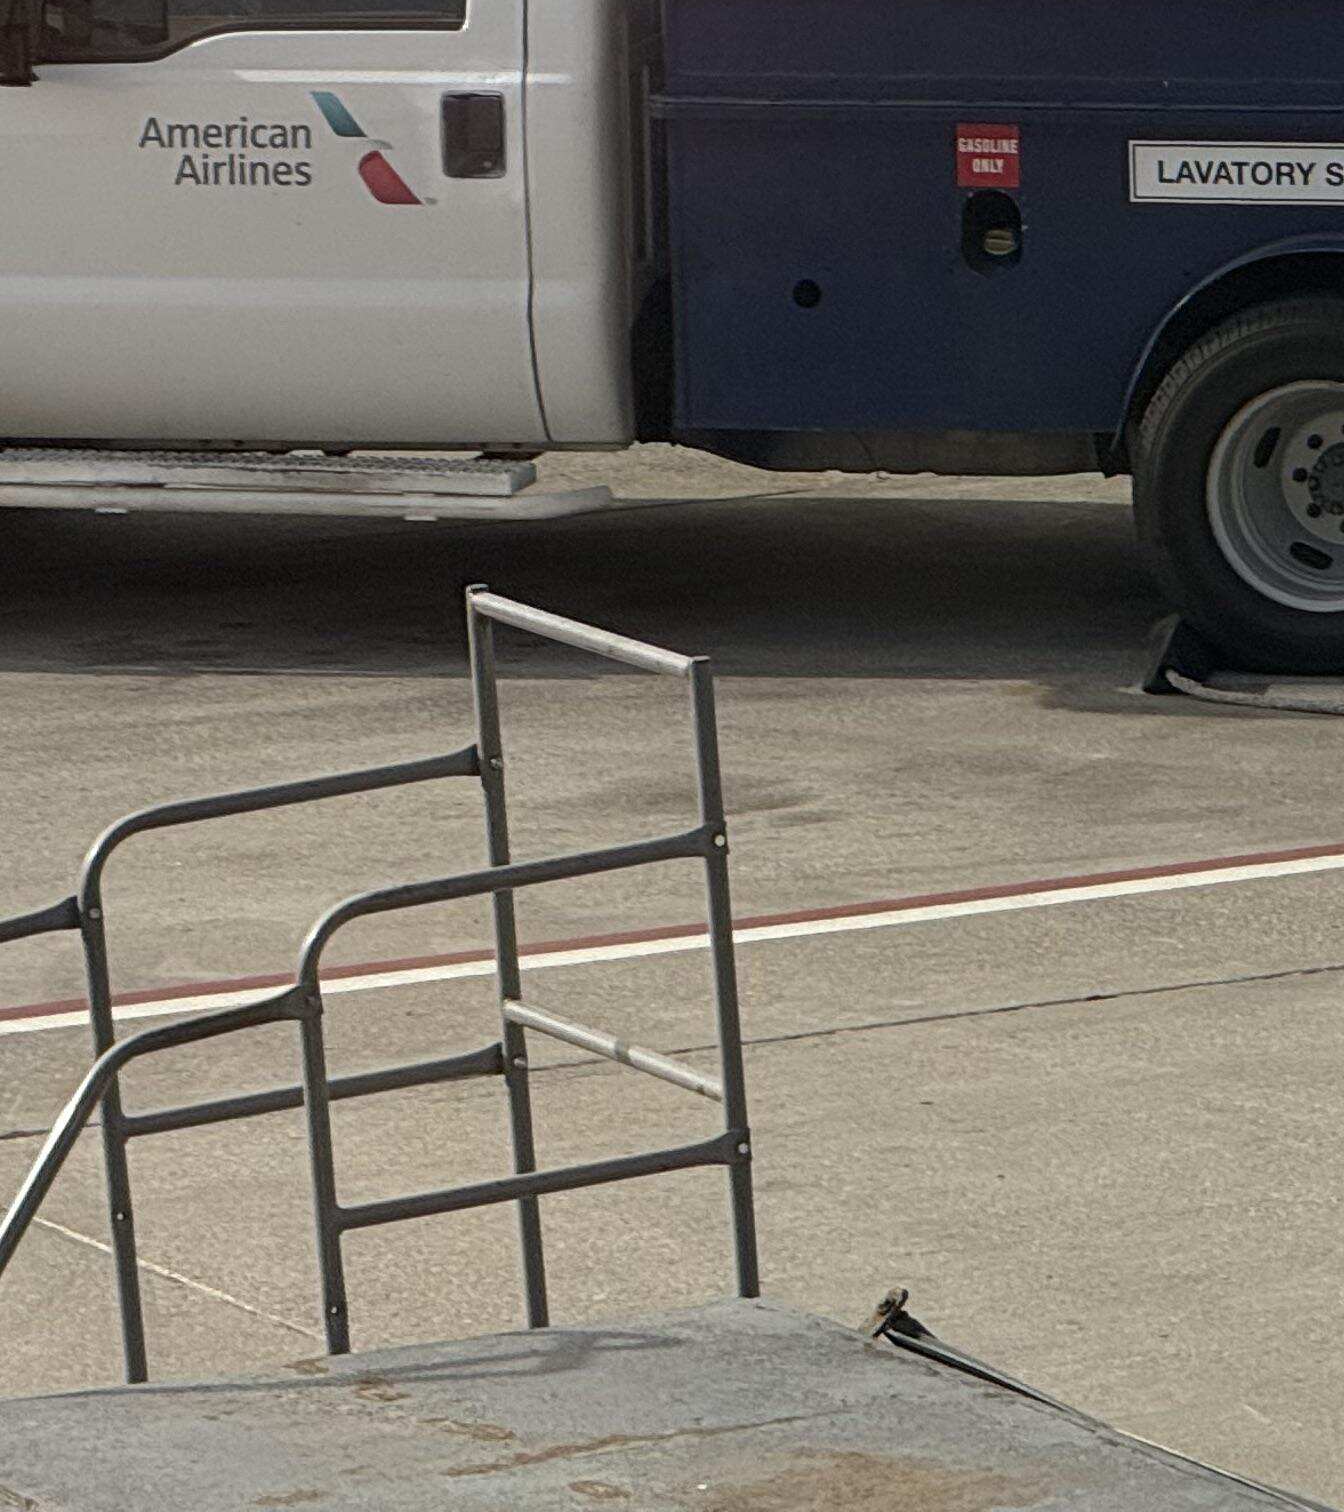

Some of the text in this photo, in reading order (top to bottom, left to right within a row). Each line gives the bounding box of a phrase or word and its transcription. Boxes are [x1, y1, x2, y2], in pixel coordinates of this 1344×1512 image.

[138, 116, 312, 149] American
[958, 137, 1019, 154] GASOLINE
[174, 153, 312, 186] Airlines
[972, 158, 1004, 174] ONLY
[1157, 160, 1317, 186] LAVATORY
